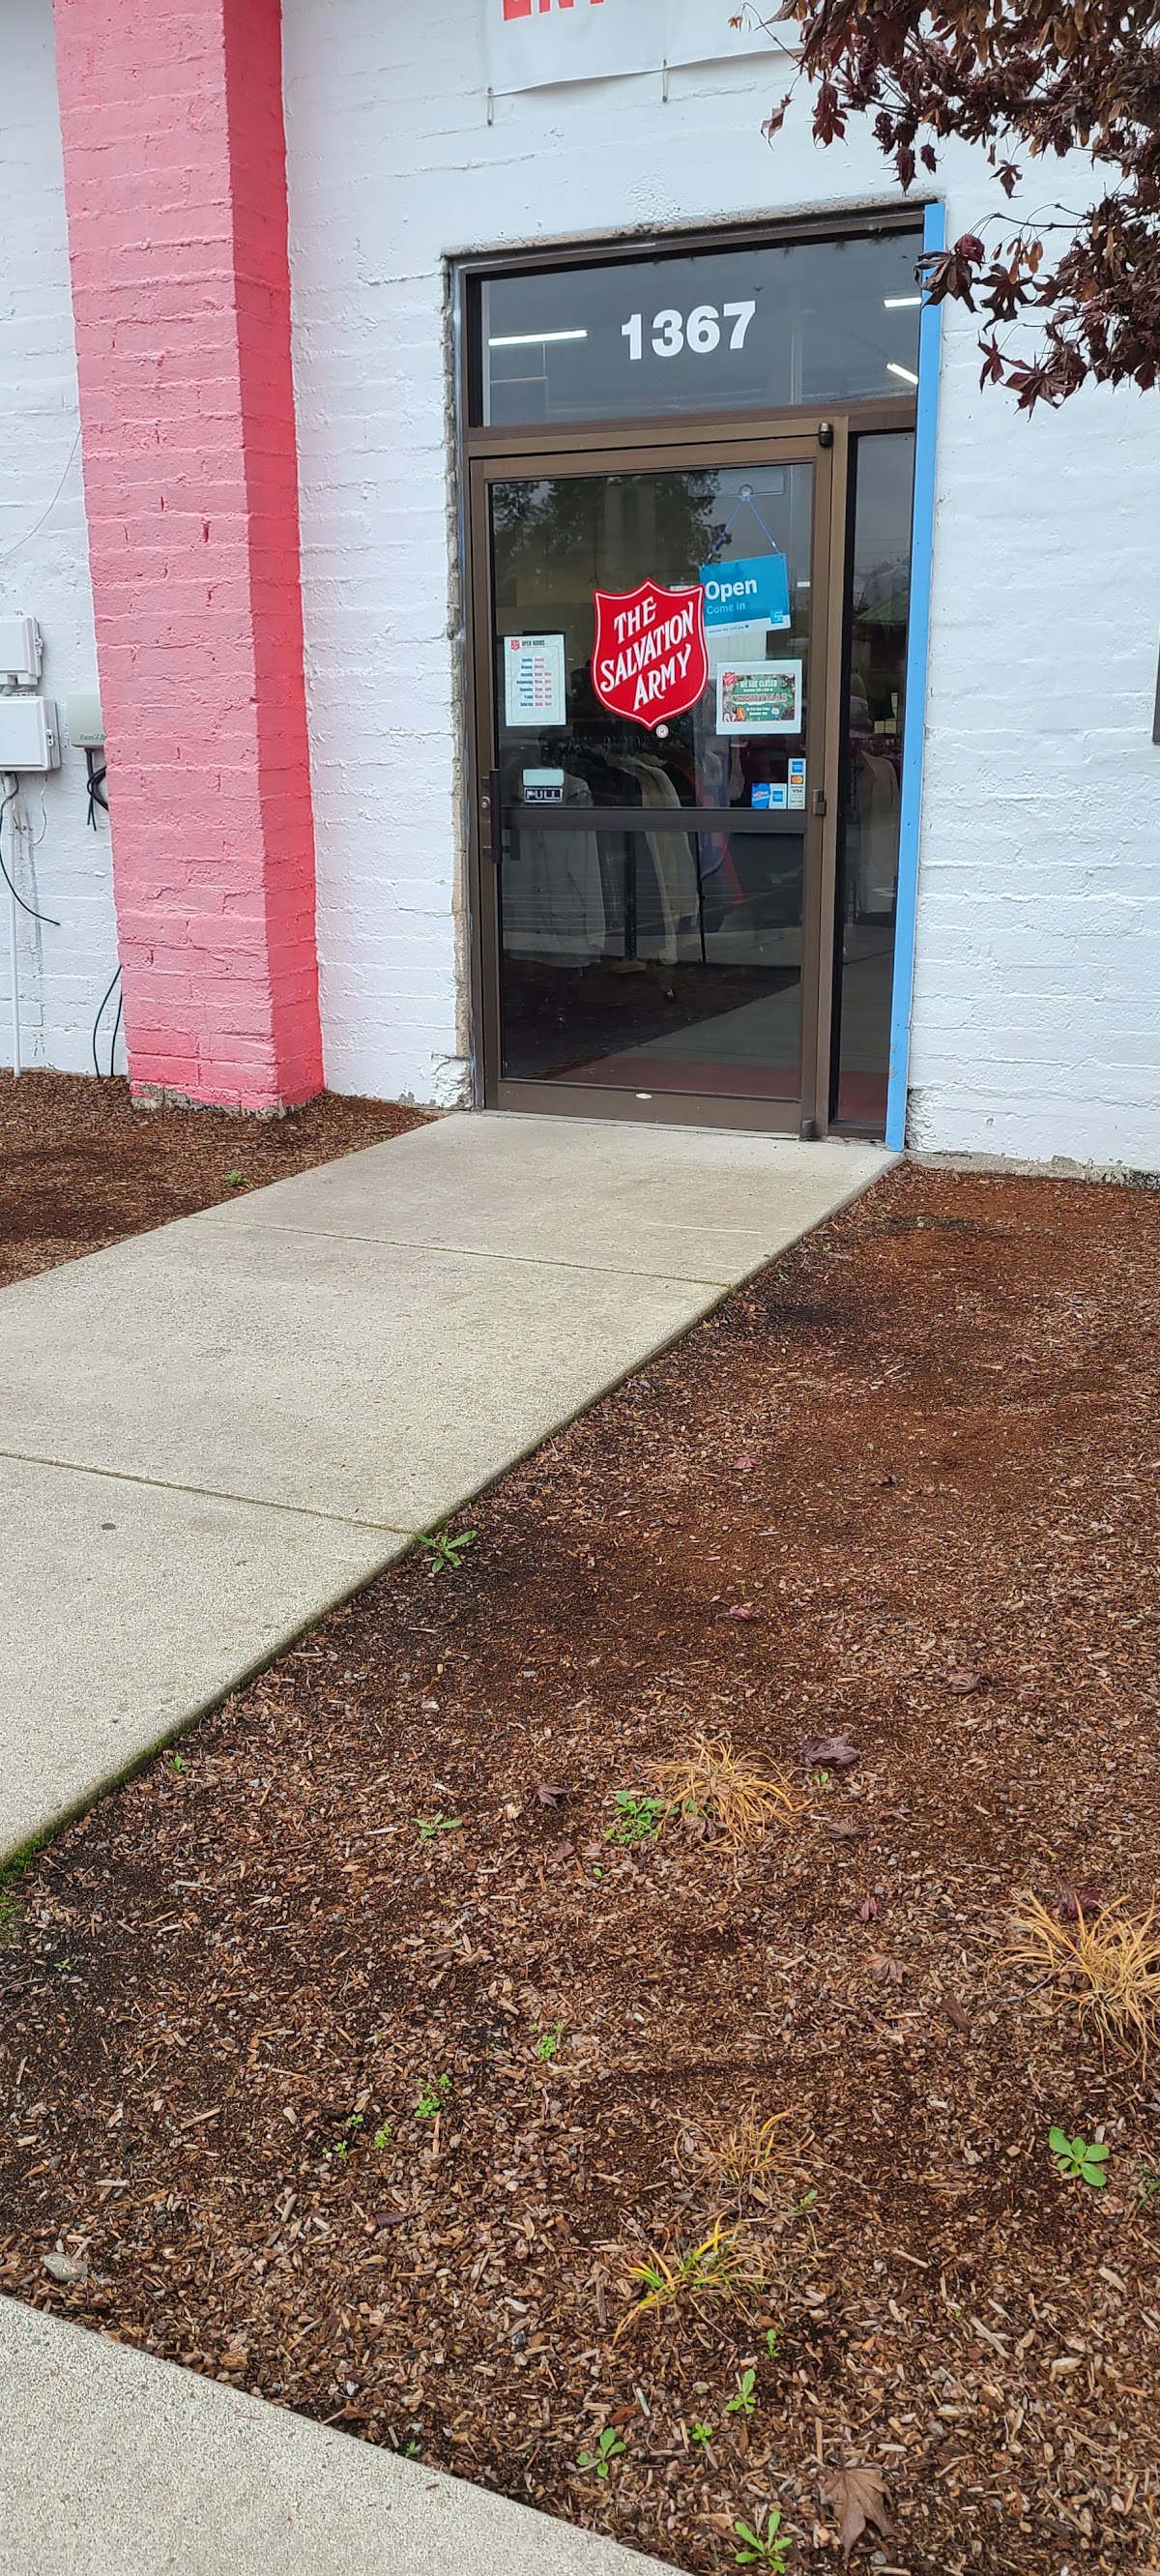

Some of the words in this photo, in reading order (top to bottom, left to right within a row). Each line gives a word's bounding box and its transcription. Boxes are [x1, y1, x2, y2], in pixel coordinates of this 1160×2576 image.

[621, 300, 756, 361] 1367
[705, 578, 758, 602] Open
[707, 603, 734, 615] Come
[736, 600, 746, 611] in
[613, 596, 657, 645] THE
[599, 600, 695, 692] SALVATION
[633, 643, 692, 713] ARMY
[526, 789, 561, 800] PULL
